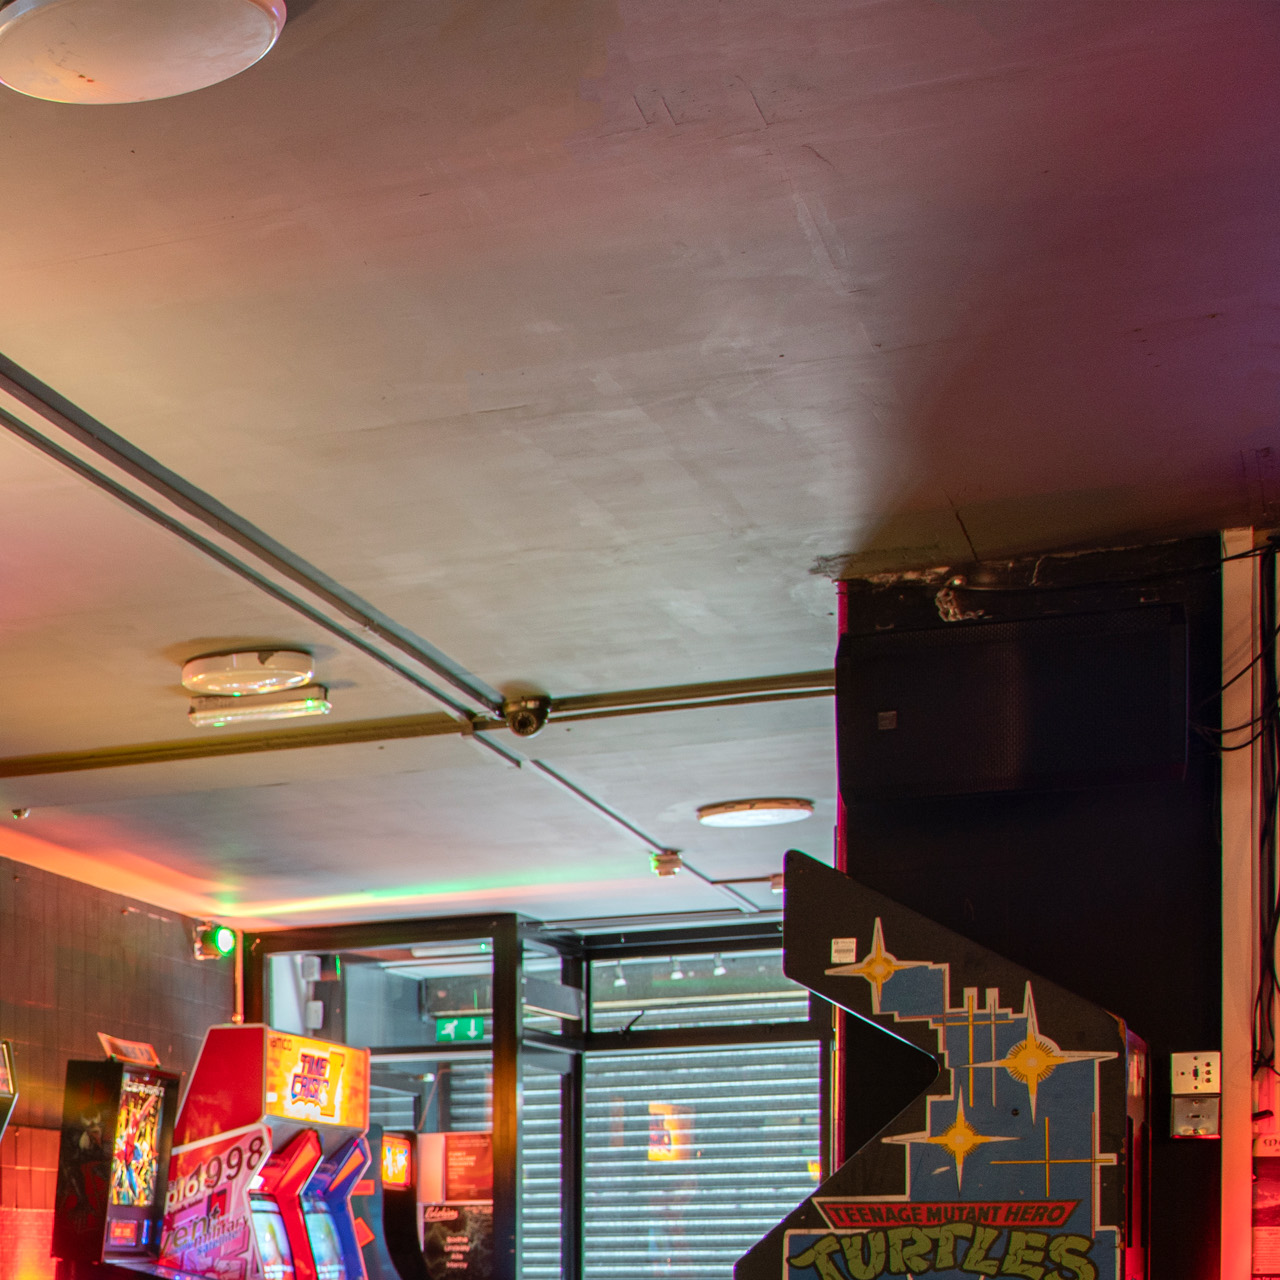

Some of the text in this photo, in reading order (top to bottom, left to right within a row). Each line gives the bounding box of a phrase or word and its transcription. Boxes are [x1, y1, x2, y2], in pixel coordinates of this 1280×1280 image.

[301, 1053, 328, 1077] TIME
[829, 1202, 1067, 1225] TEENAGE MUTANT HERO
